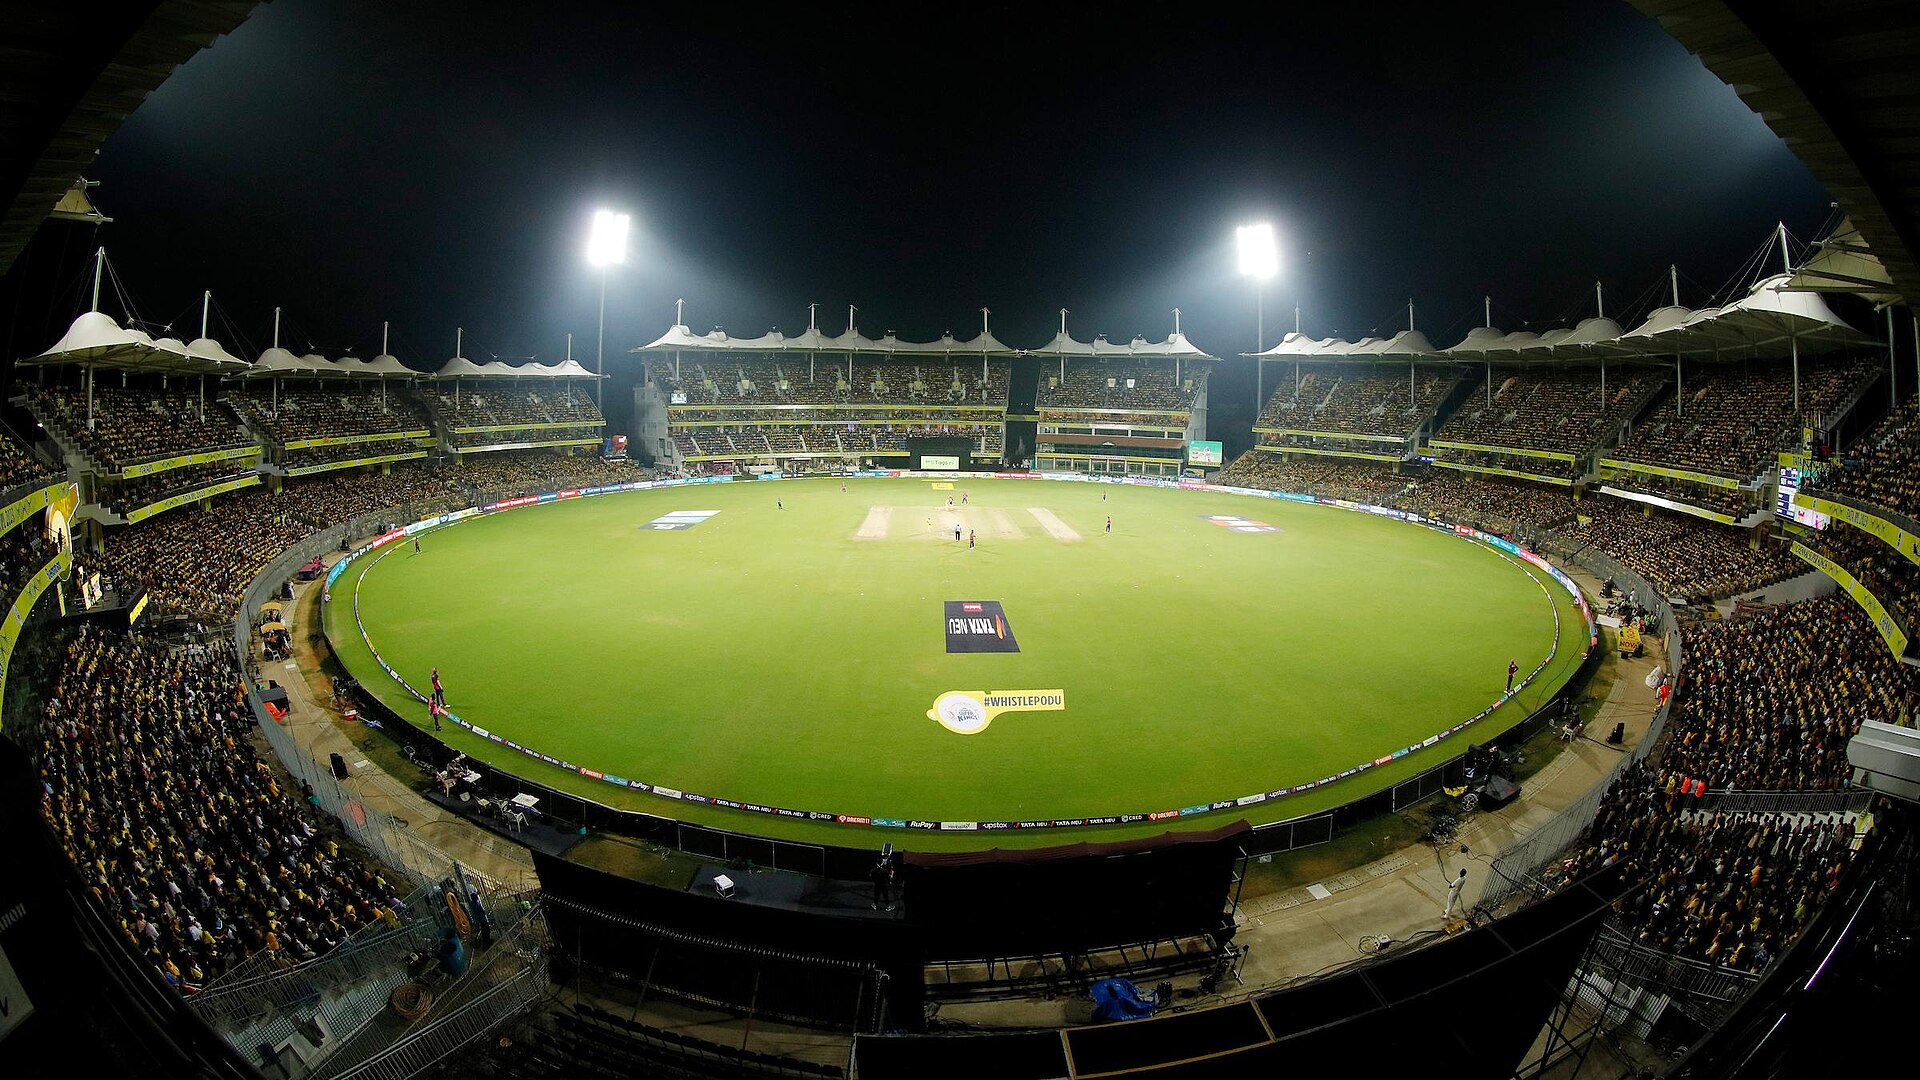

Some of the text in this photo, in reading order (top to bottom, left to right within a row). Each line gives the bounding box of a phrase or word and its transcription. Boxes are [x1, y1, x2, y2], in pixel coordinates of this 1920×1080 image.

[949, 618, 995, 634] TATA NEU
[984, 696, 1061, 707] #WHISTLEPODU
[910, 821, 933, 829] RuPay
